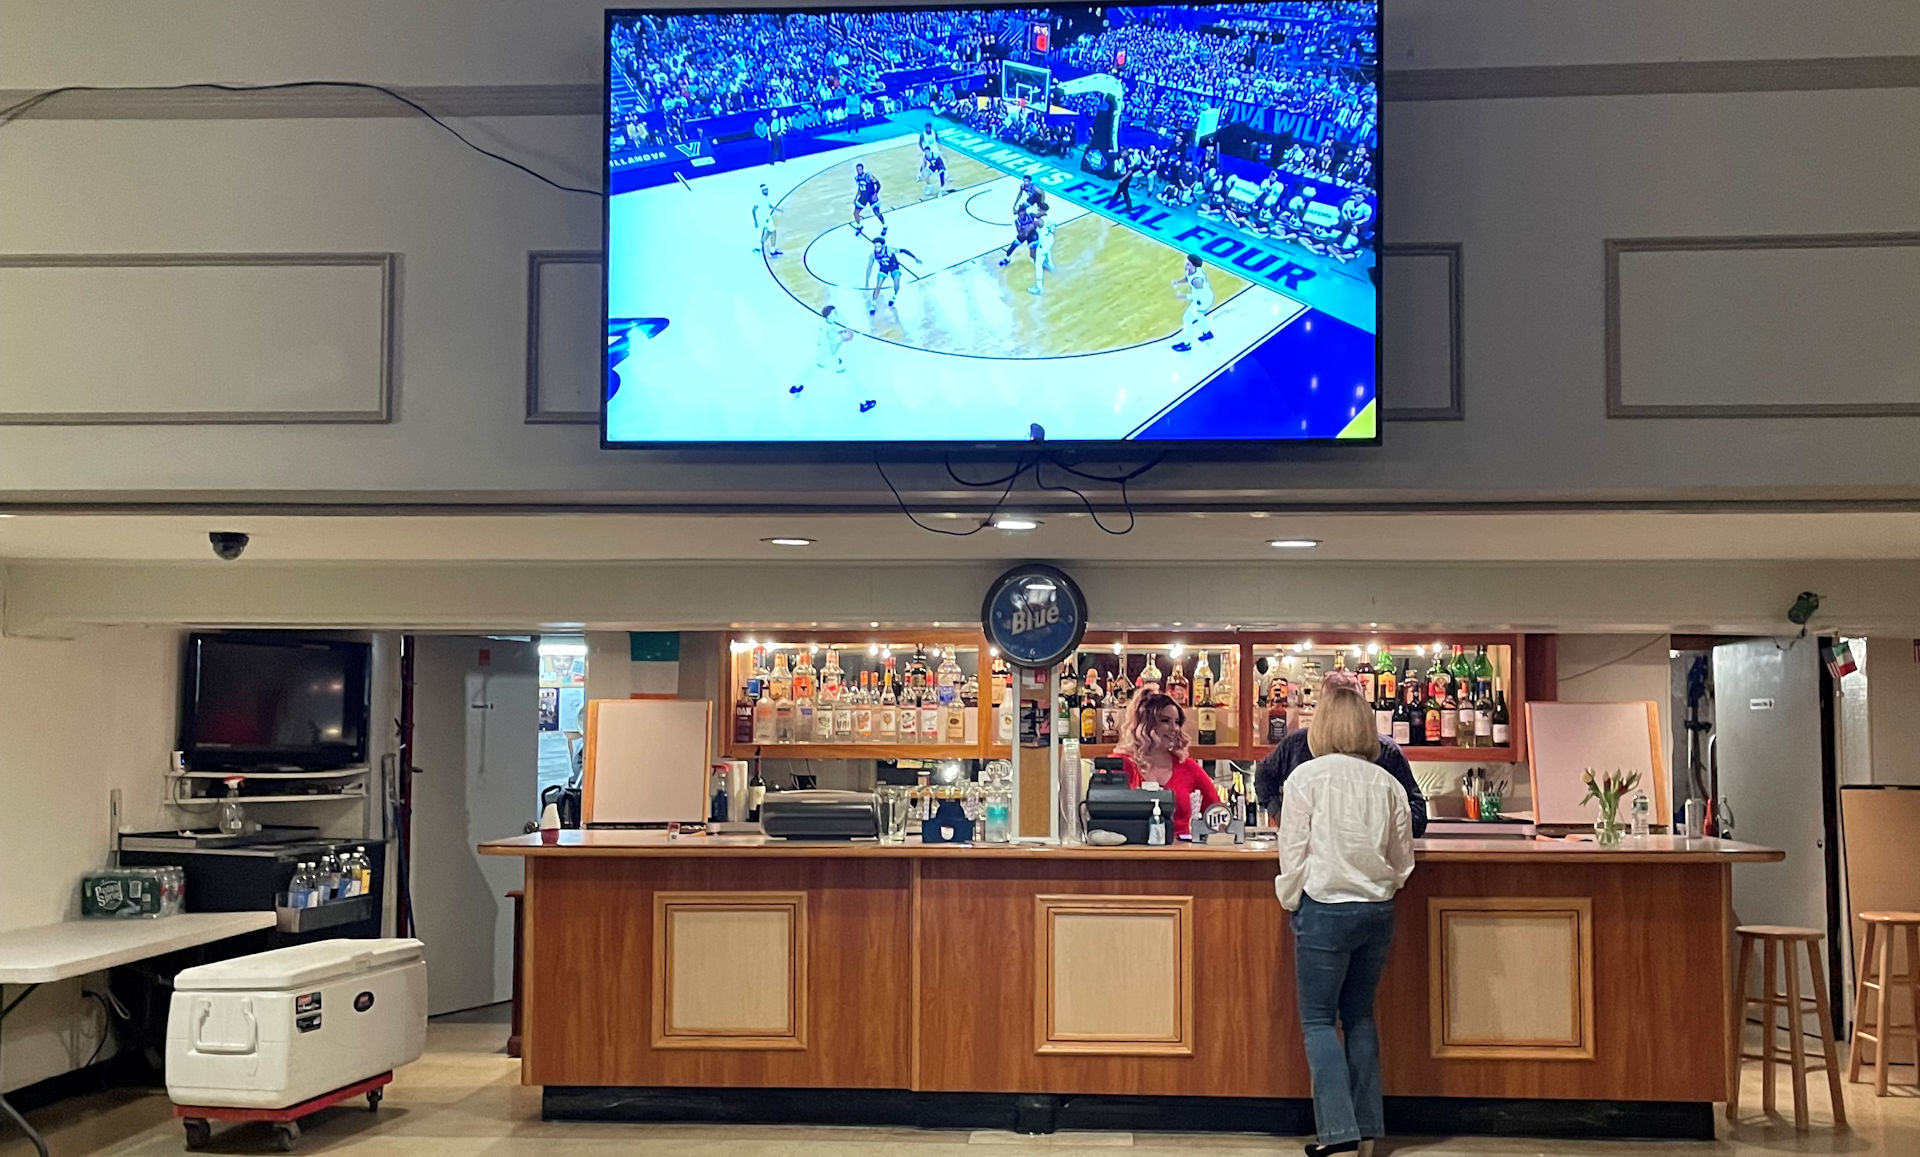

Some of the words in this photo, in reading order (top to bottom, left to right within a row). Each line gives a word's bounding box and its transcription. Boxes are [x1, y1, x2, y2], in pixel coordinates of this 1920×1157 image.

[982, 148, 1075, 187] MEN'S
[1062, 180, 1170, 232] FINAL
[1173, 223, 1318, 291] FOUR
[1011, 605, 1060, 636] Blue
